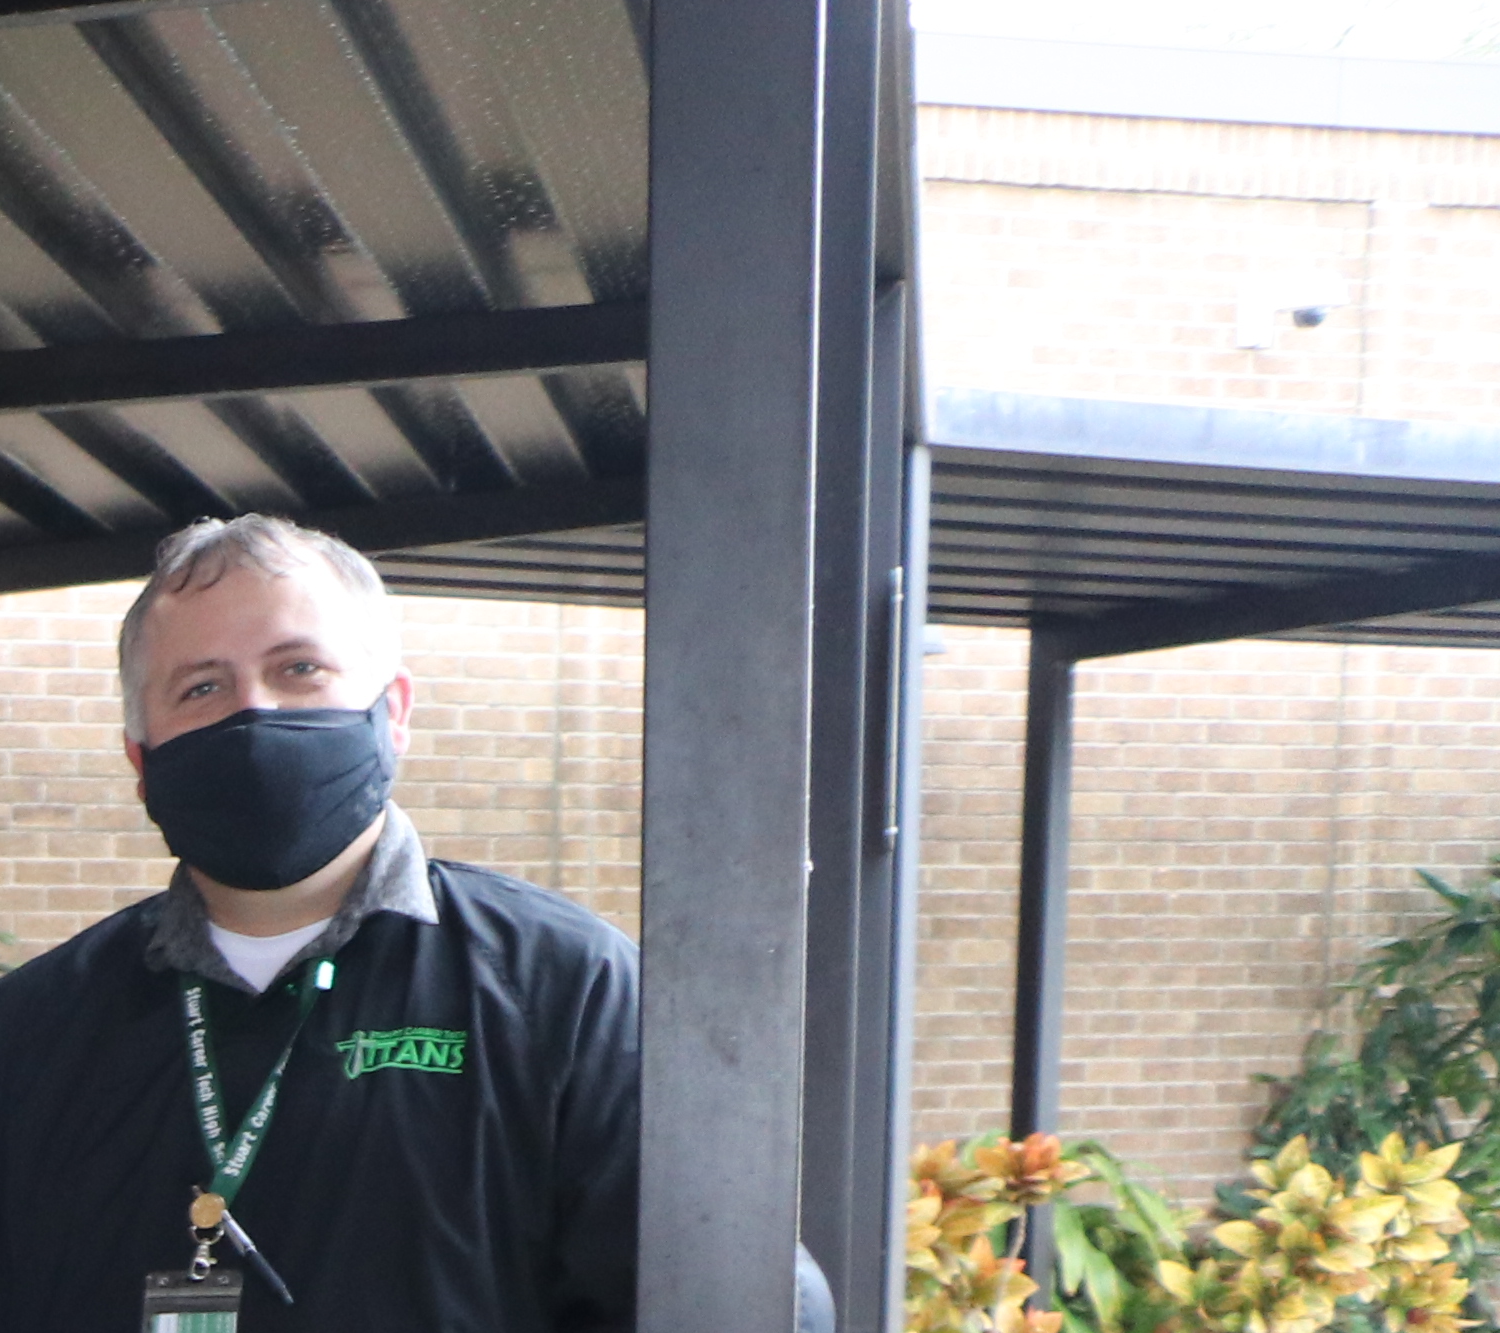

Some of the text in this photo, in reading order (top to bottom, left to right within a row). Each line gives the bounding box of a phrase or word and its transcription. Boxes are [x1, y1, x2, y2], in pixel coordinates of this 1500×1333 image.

[185, 986, 204, 1027] Stuart
[189, 1029, 208, 1068] Career
[197, 1072, 216, 1103] Tech
[201, 1105, 222, 1140] High
[222, 1081, 278, 1177] Stuart Career
